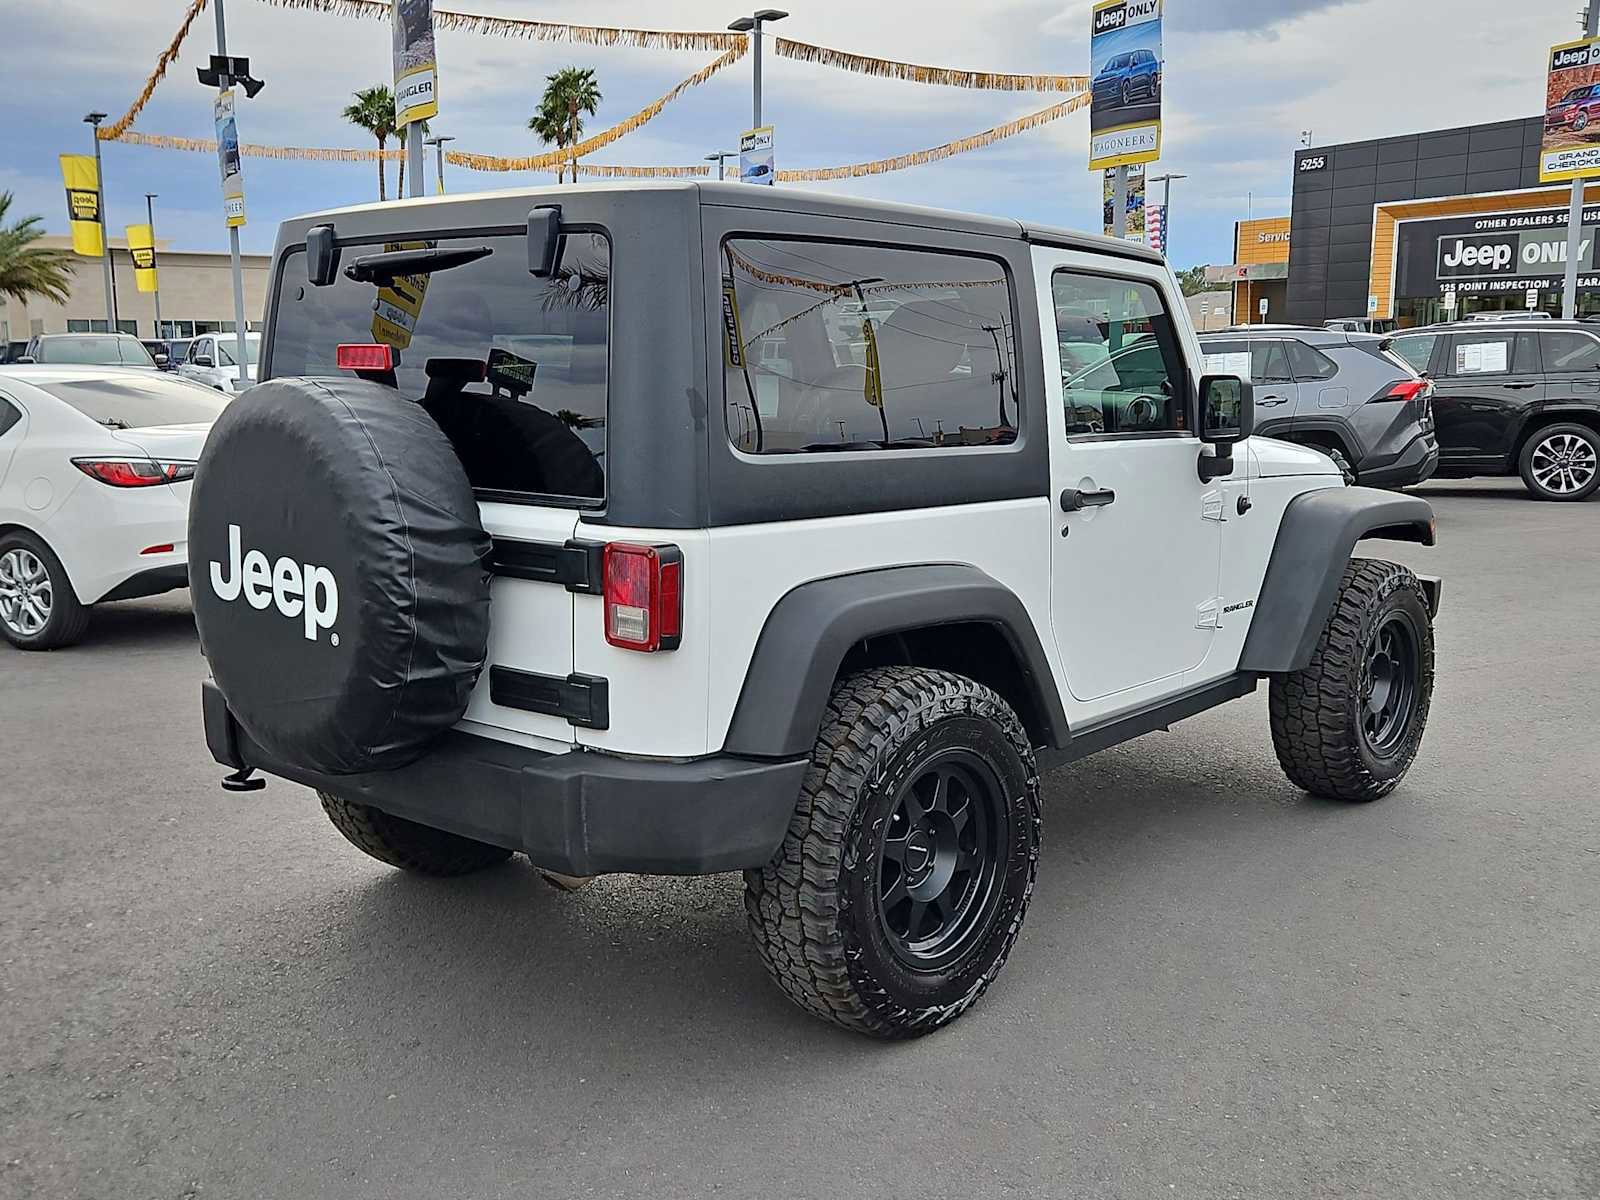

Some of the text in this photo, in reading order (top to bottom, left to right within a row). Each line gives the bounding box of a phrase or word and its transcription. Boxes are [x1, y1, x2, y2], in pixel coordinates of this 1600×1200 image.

[1096, 0, 1157, 28] Jeep ONLY
[1554, 50, 1588, 66] Jeep
[1558, 149, 1599, 161] GRAND
[1300, 157, 1324, 171] 5255
[1475, 218, 1507, 229] OTHER
[1509, 215, 1554, 226] DEALERS
[1557, 213, 1570, 223] SE
[1443, 239, 1591, 270] Jeep ONLY
[1440, 283, 1456, 292] 125
[1458, 282, 1488, 291] POINT
[1490, 280, 1549, 290] INSPECTION
[209, 524, 339, 641] Jeep
